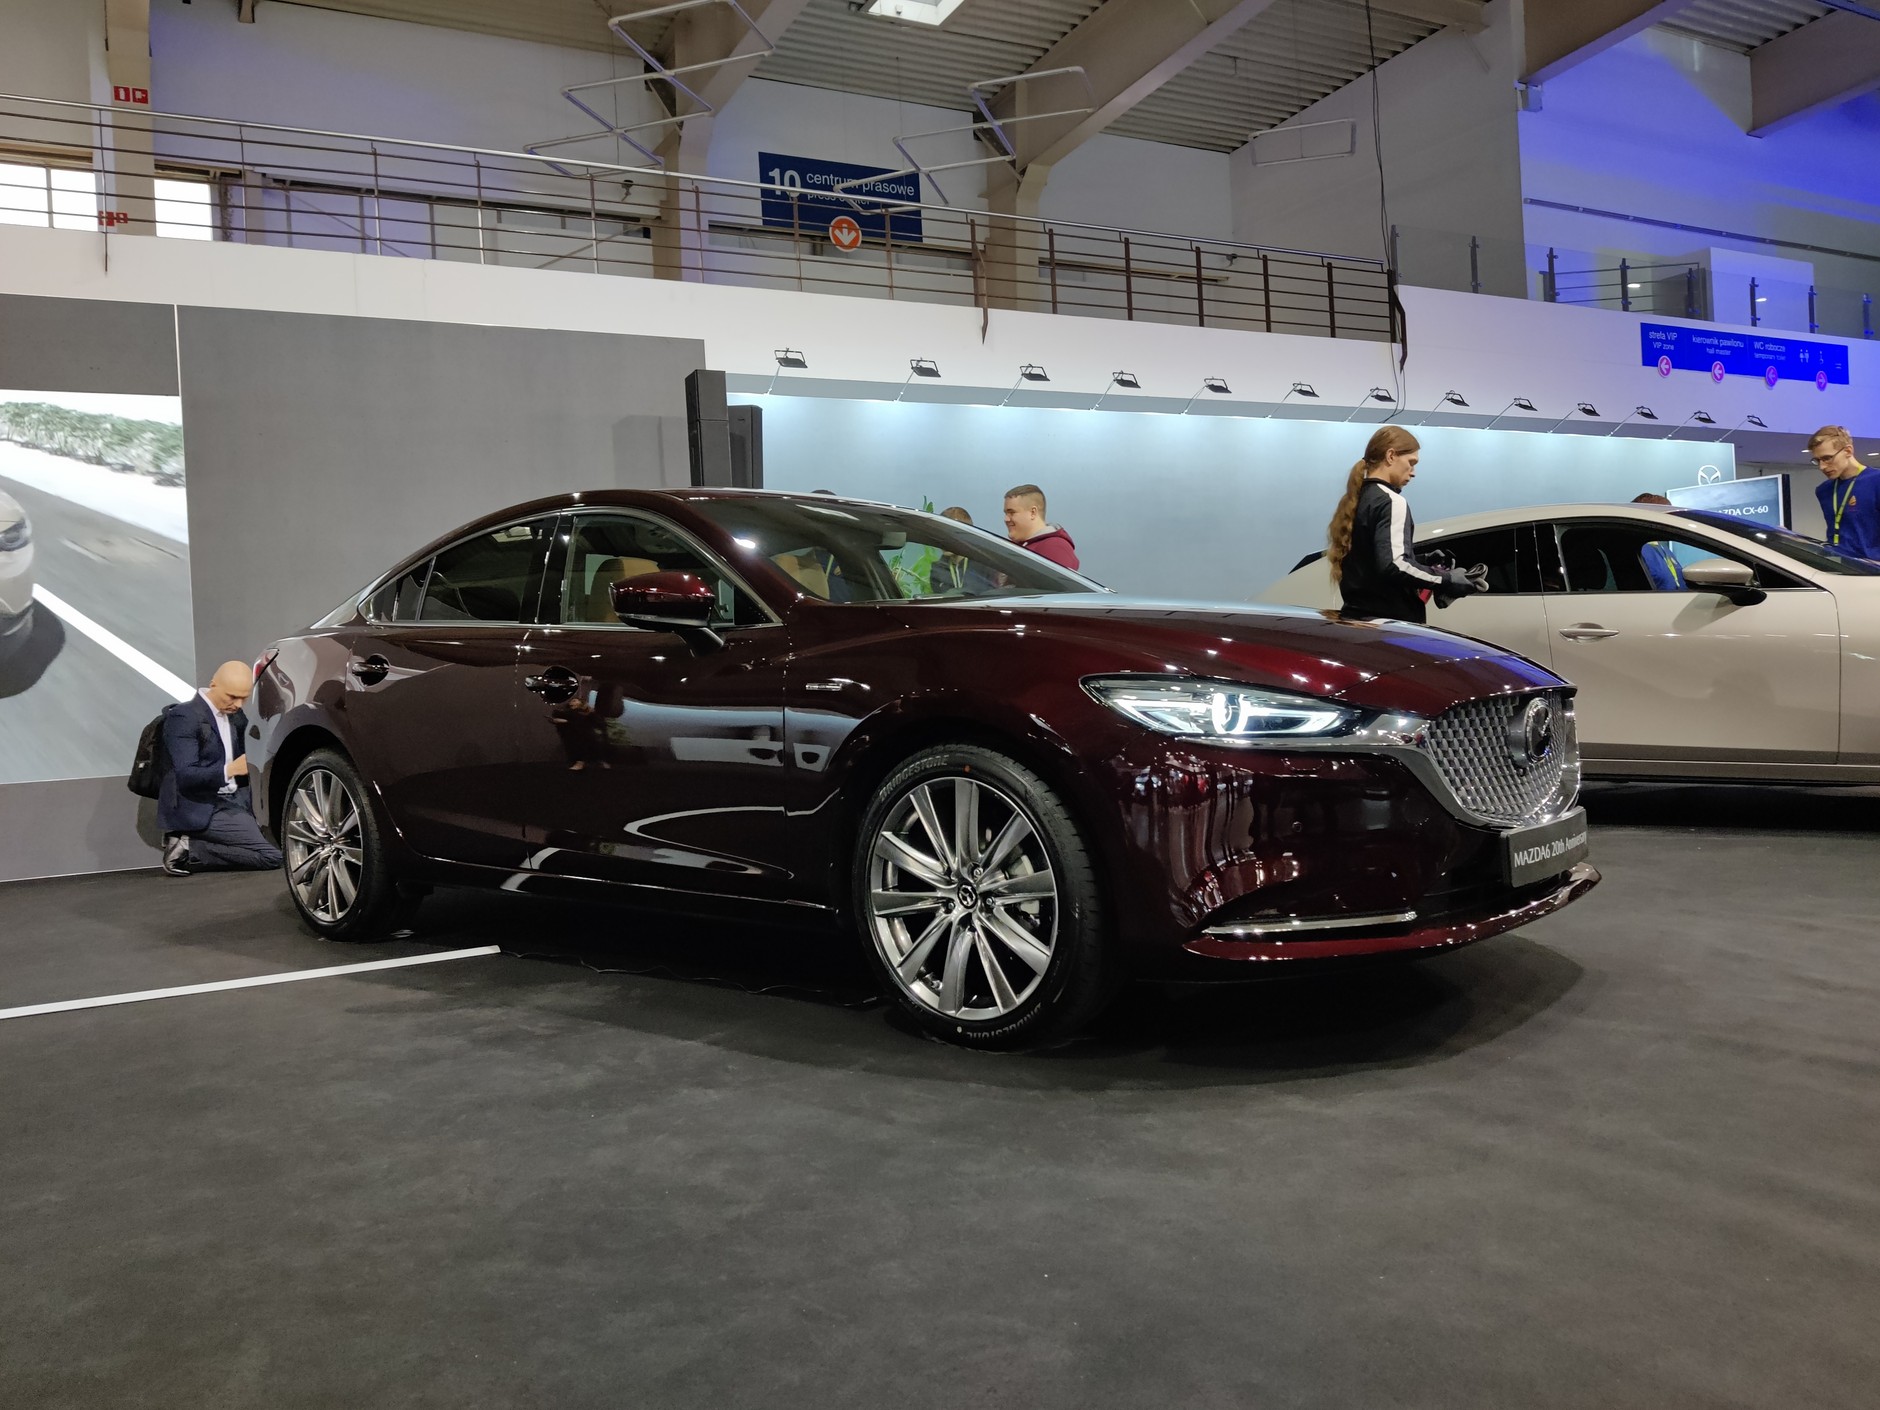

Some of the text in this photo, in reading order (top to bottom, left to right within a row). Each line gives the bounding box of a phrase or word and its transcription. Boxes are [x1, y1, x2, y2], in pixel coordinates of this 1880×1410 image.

[768, 167, 801, 198] 10
[862, 181, 915, 196] prasowe
[1648, 331, 1678, 341] strefa VIP
[1692, 335, 1719, 345] kierownik
[1652, 341, 1662, 349] VIP
[1753, 341, 1764, 350] WC
[1742, 505, 1769, 515] CX-60
[878, 754, 950, 802] BRIDGESTONE
[1514, 843, 1551, 868] MAZDA6
[1551, 838, 1565, 857] 20th
